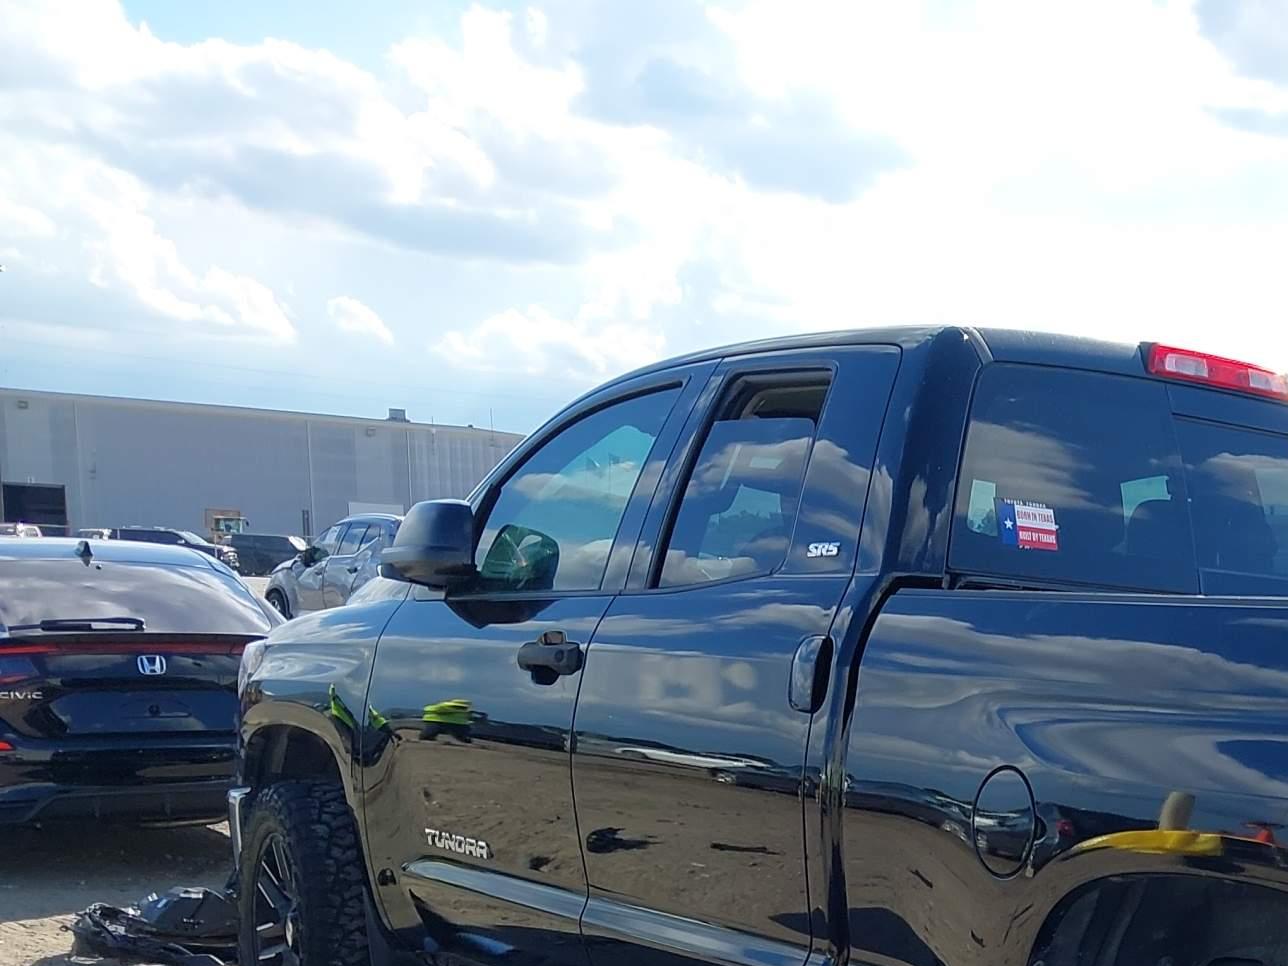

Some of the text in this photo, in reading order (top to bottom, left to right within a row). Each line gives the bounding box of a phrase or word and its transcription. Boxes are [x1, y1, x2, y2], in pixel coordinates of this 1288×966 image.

[1017, 510, 1031, 520] BORN
[1038, 512, 1054, 524] TEXAS
[807, 541, 840, 557] SR5
[424, 827, 489, 860] TUNDRA
